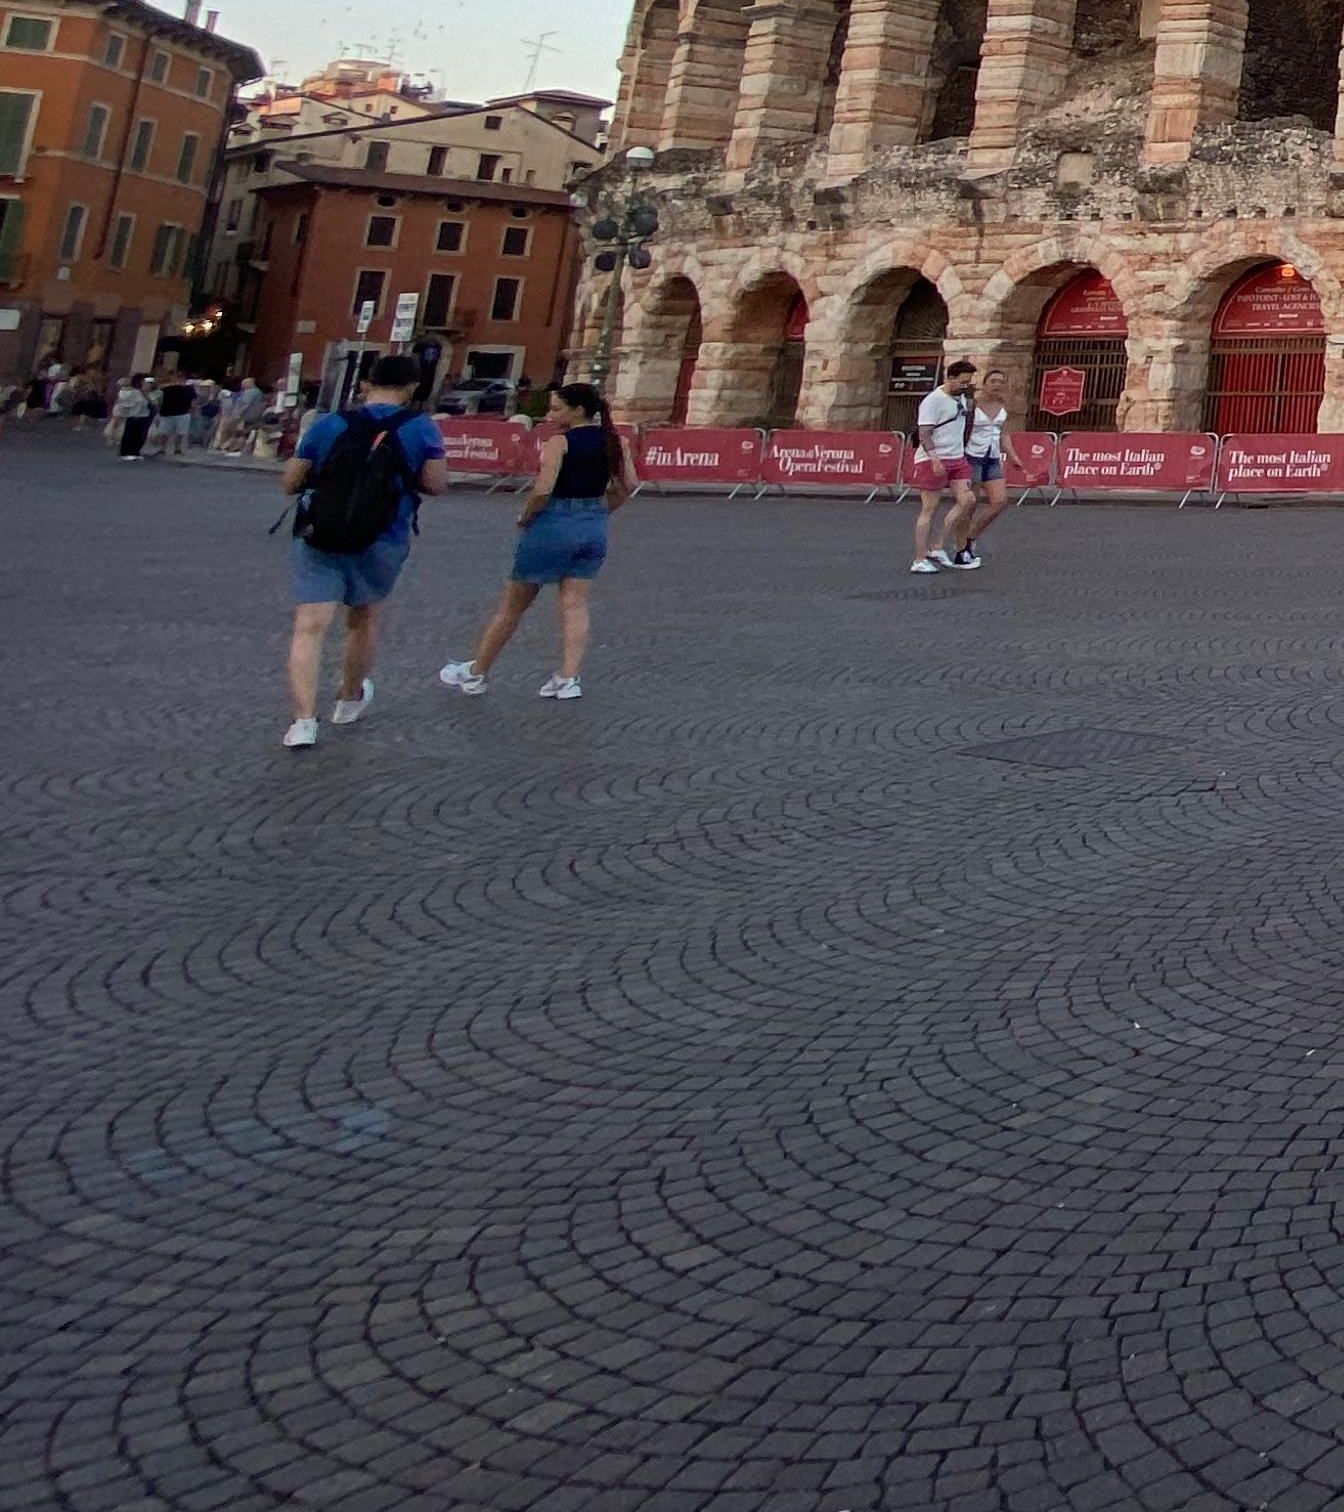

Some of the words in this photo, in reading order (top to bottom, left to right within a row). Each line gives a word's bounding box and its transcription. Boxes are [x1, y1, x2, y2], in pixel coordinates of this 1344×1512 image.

[645, 446, 720, 467] #inArena
[1066, 448, 1090, 462] The
[1092, 449, 1121, 462] most
[1124, 448, 1165, 463] Italian
[1228, 450, 1255, 464] The
[1257, 451, 1287, 464] most
[1290, 450, 1331, 464] Italian
[1064, 462, 1099, 478] place
[1101, 465, 1117, 476] on
[1228, 464, 1264, 481] place
[1266, 467, 1284, 478] on
